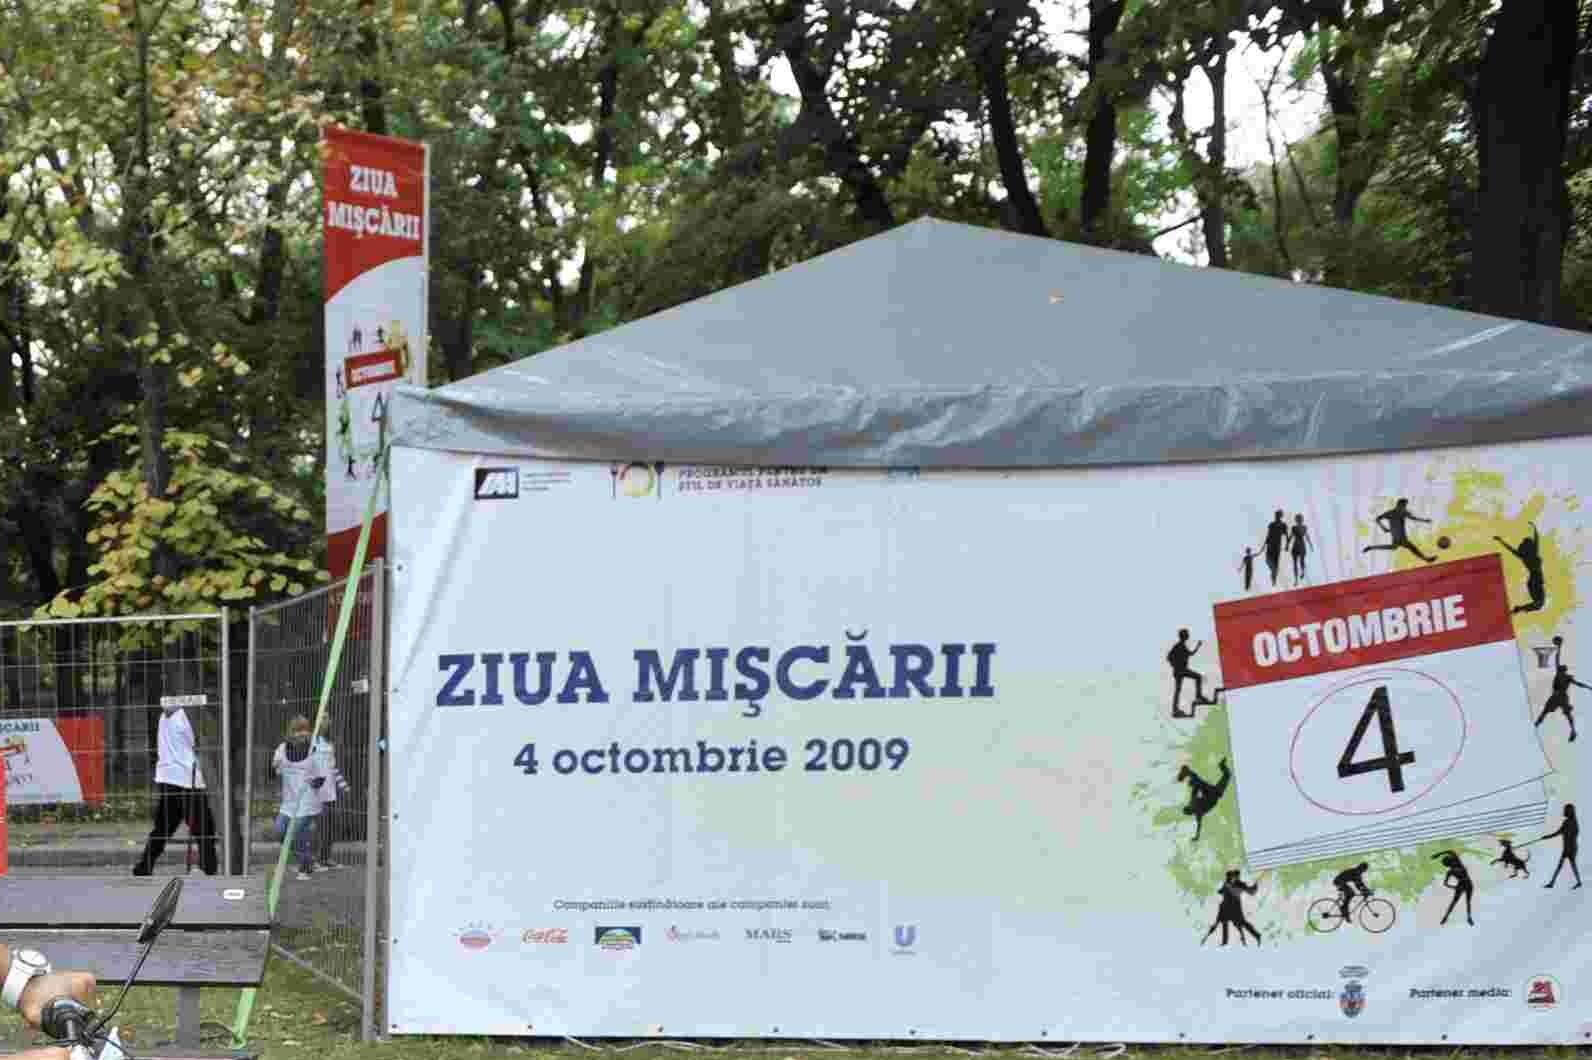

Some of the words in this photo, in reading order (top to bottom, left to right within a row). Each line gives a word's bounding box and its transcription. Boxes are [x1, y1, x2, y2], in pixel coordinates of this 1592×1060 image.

[349, 165, 399, 198] ZIUA
[1252, 594, 1467, 668] OCTOMBRIE
[436, 650, 610, 706] ZIUA
[513, 743, 539, 775] 4
[552, 740, 788, 775] octombrie
[804, 737, 910, 772] 2009
[1336, 684, 1416, 794] 4
[1225, 986, 1285, 1000] Partener
[1409, 987, 1464, 999] Partener
